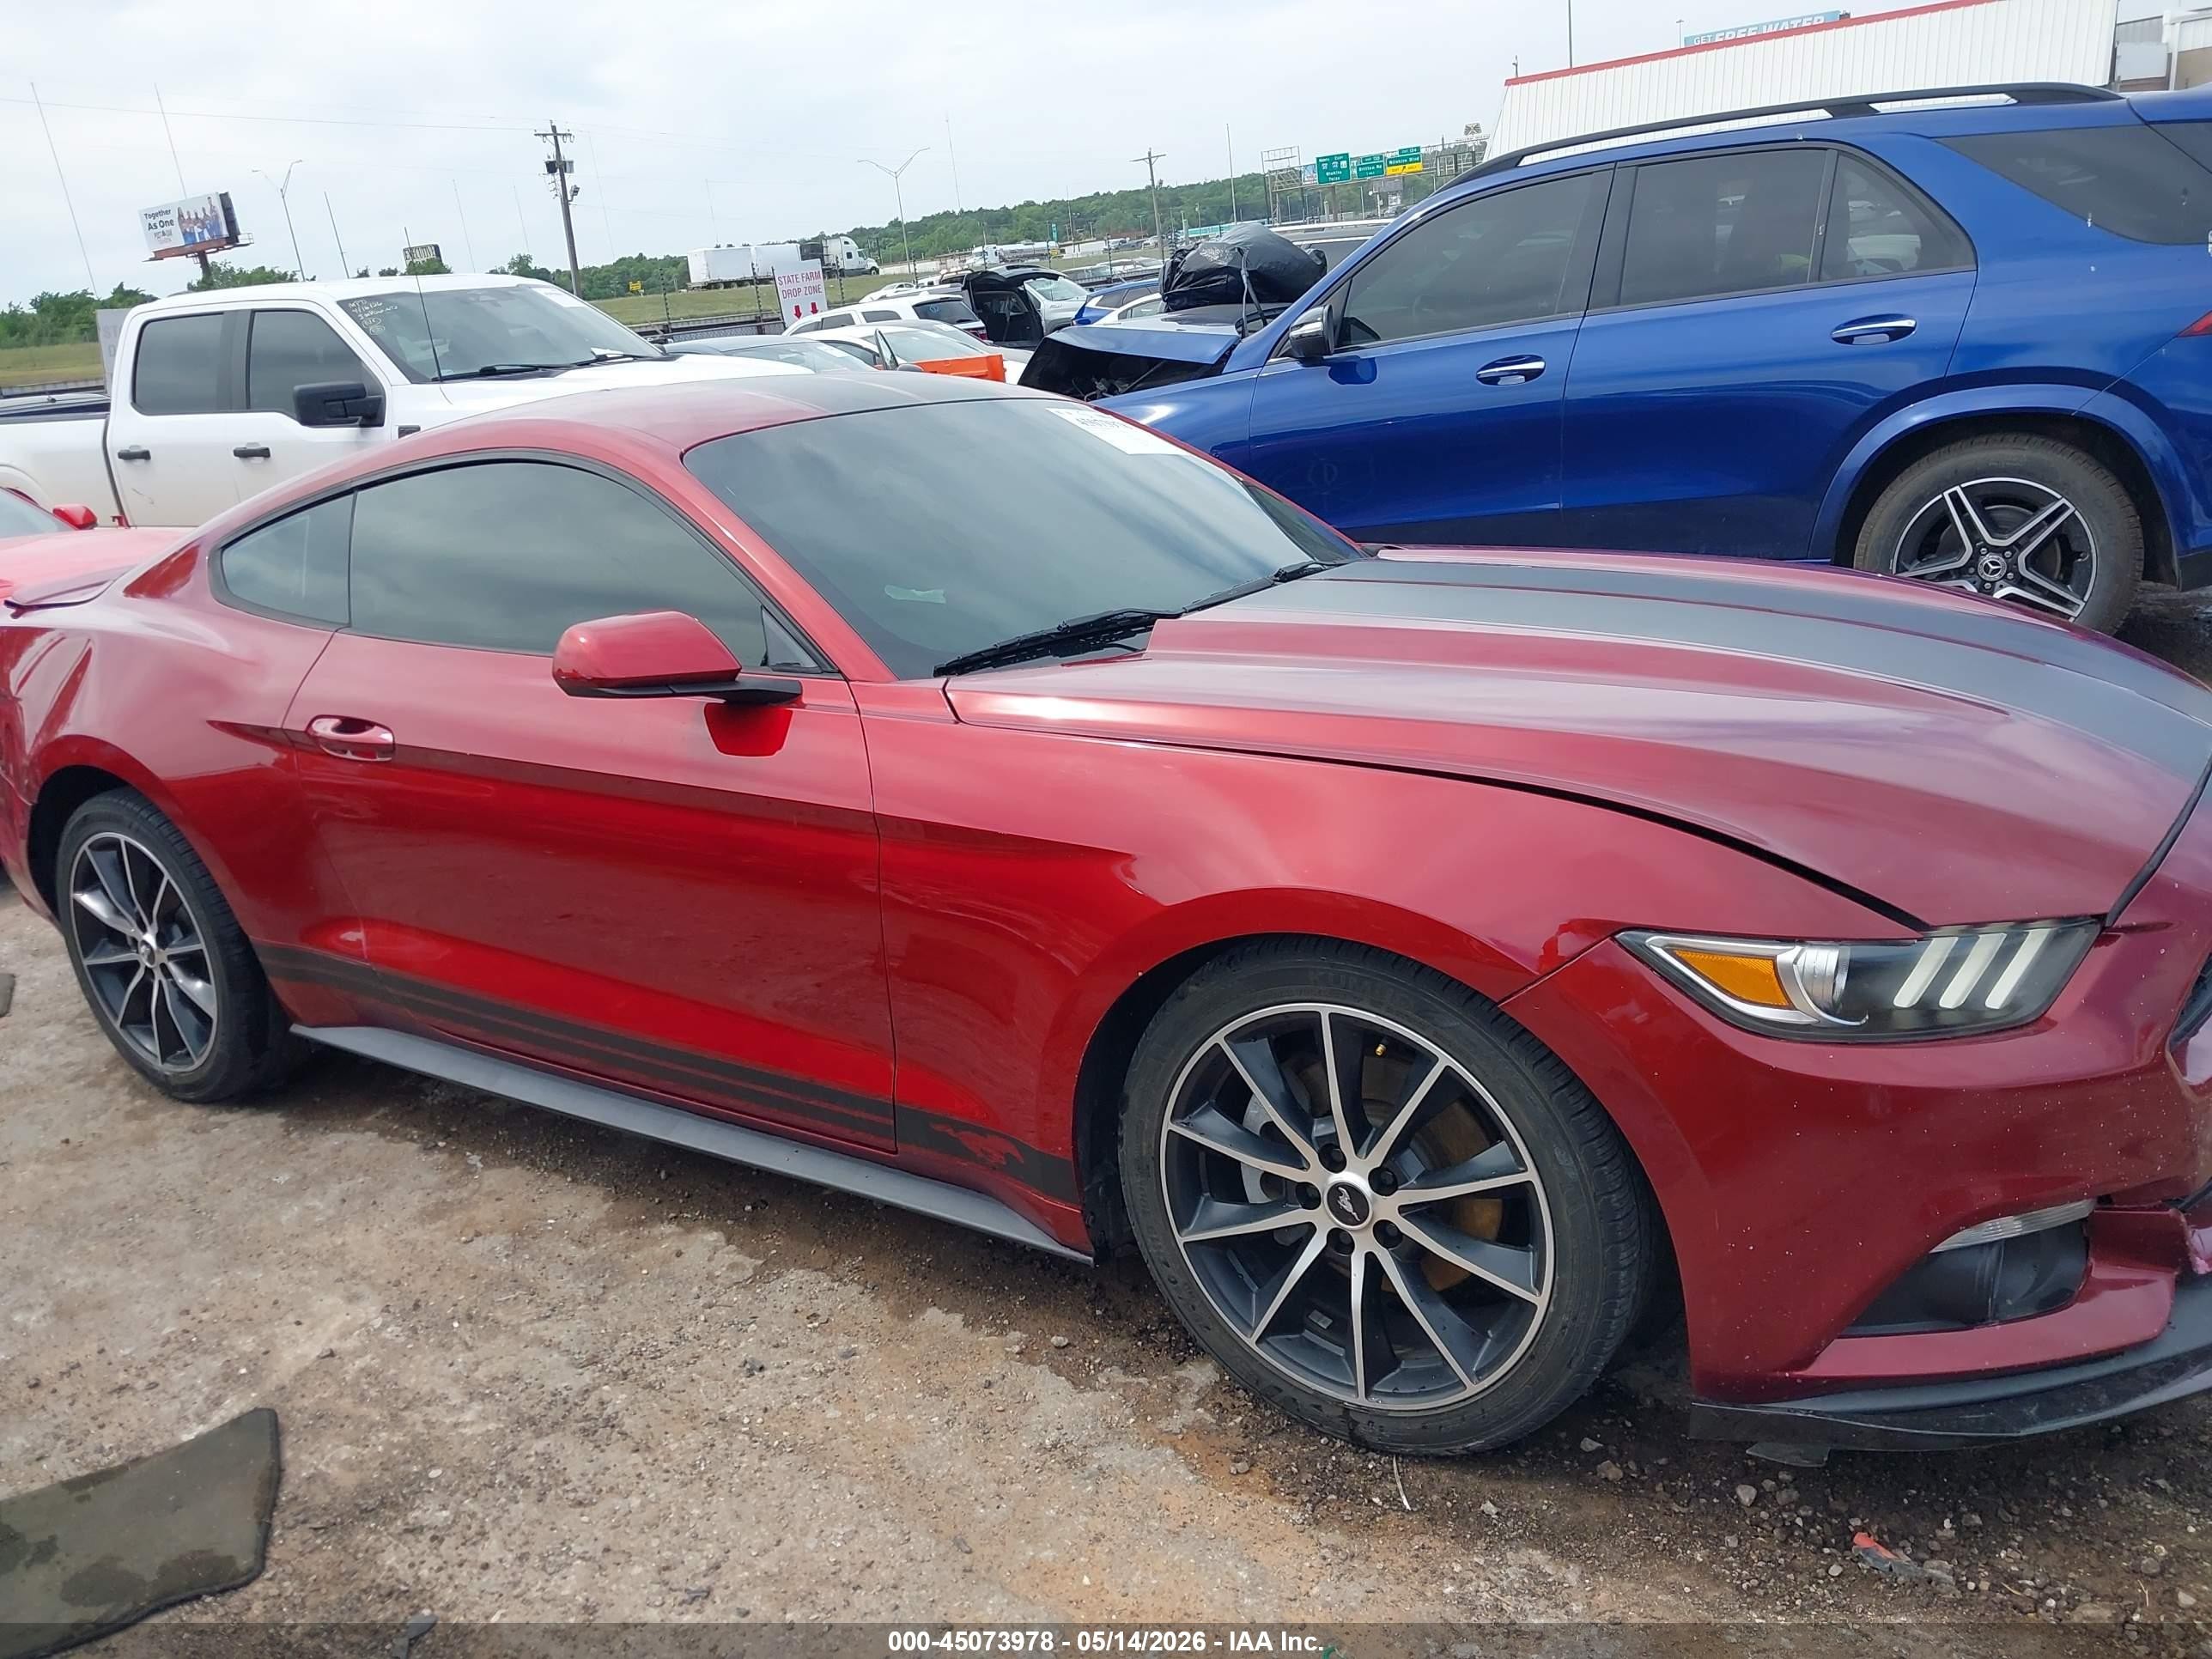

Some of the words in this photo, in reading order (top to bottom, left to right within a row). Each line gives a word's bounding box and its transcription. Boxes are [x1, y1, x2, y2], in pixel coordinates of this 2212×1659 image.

[1693, 34, 1712, 45] GET
[144, 209, 172, 220] Together
[148, 221, 158, 231] As
[159, 219, 174, 228] One
[777, 274, 800, 287] STATE
[801, 270, 822, 283] FARM
[781, 287, 802, 300] DROP
[804, 284, 823, 296] ZONE
